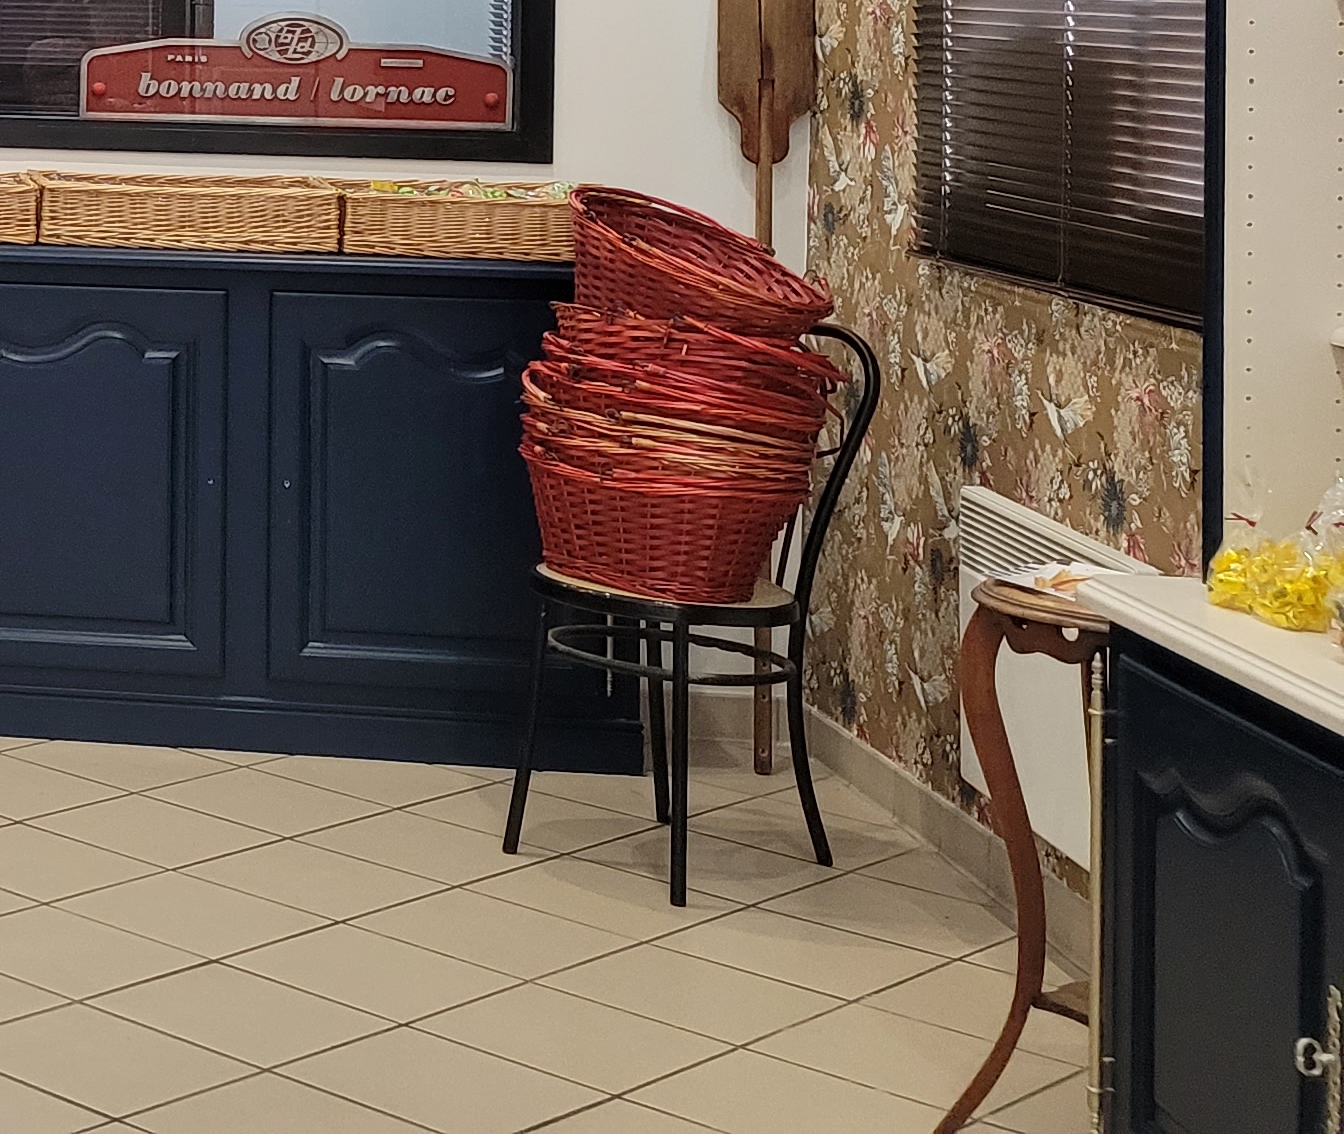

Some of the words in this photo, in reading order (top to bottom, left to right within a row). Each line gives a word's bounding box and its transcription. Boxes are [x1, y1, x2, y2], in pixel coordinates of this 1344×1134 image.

[167, 53, 209, 64] PARIS
[137, 72, 302, 101] bonnand
[329, 78, 457, 105] lornac
